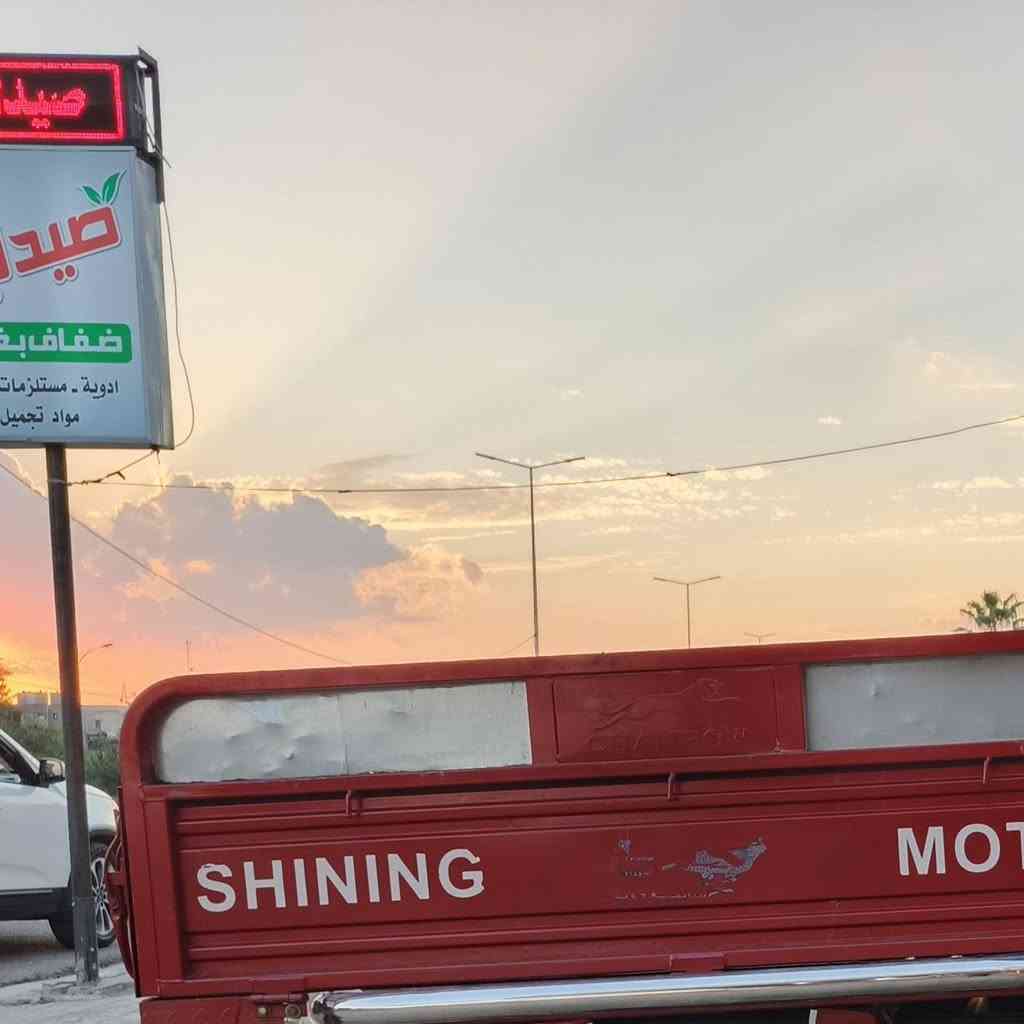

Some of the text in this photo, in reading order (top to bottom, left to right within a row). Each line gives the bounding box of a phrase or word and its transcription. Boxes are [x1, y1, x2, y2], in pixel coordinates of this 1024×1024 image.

[28, 327, 123, 353] ضفاف
[80, 376, 119, 399] ادوية
[0, 406, 79, 430] مواد تجميل
[197, 848, 485, 913] SHINING
